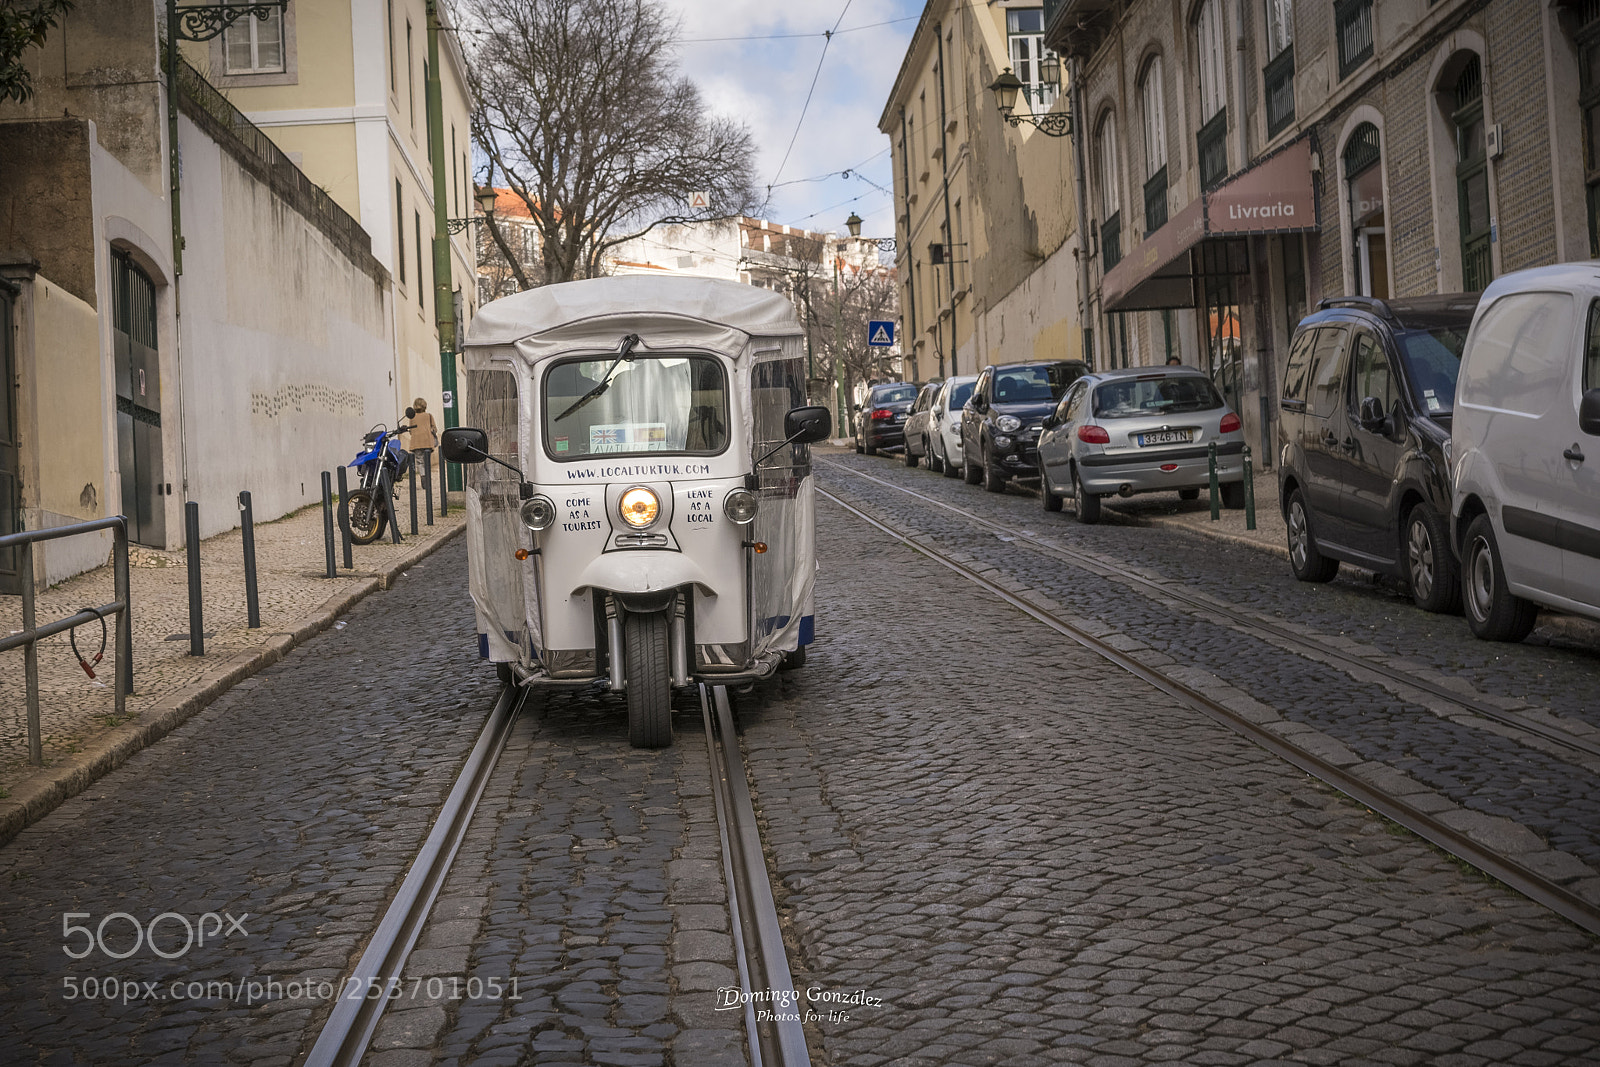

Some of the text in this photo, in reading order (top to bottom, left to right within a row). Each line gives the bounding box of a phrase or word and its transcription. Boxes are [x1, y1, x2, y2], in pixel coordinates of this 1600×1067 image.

[1229, 201, 1295, 220] Livraria
[566, 464, 710, 480] WWW.LOCALTUKTUK.COM
[687, 490, 713, 499] LEAVE
[566, 497, 591, 508] COME
[690, 502, 711, 511] AS A
[569, 509, 590, 519] AS A
[687, 513, 714, 523] LOCAL
[562, 520, 602, 532] TOURIST
